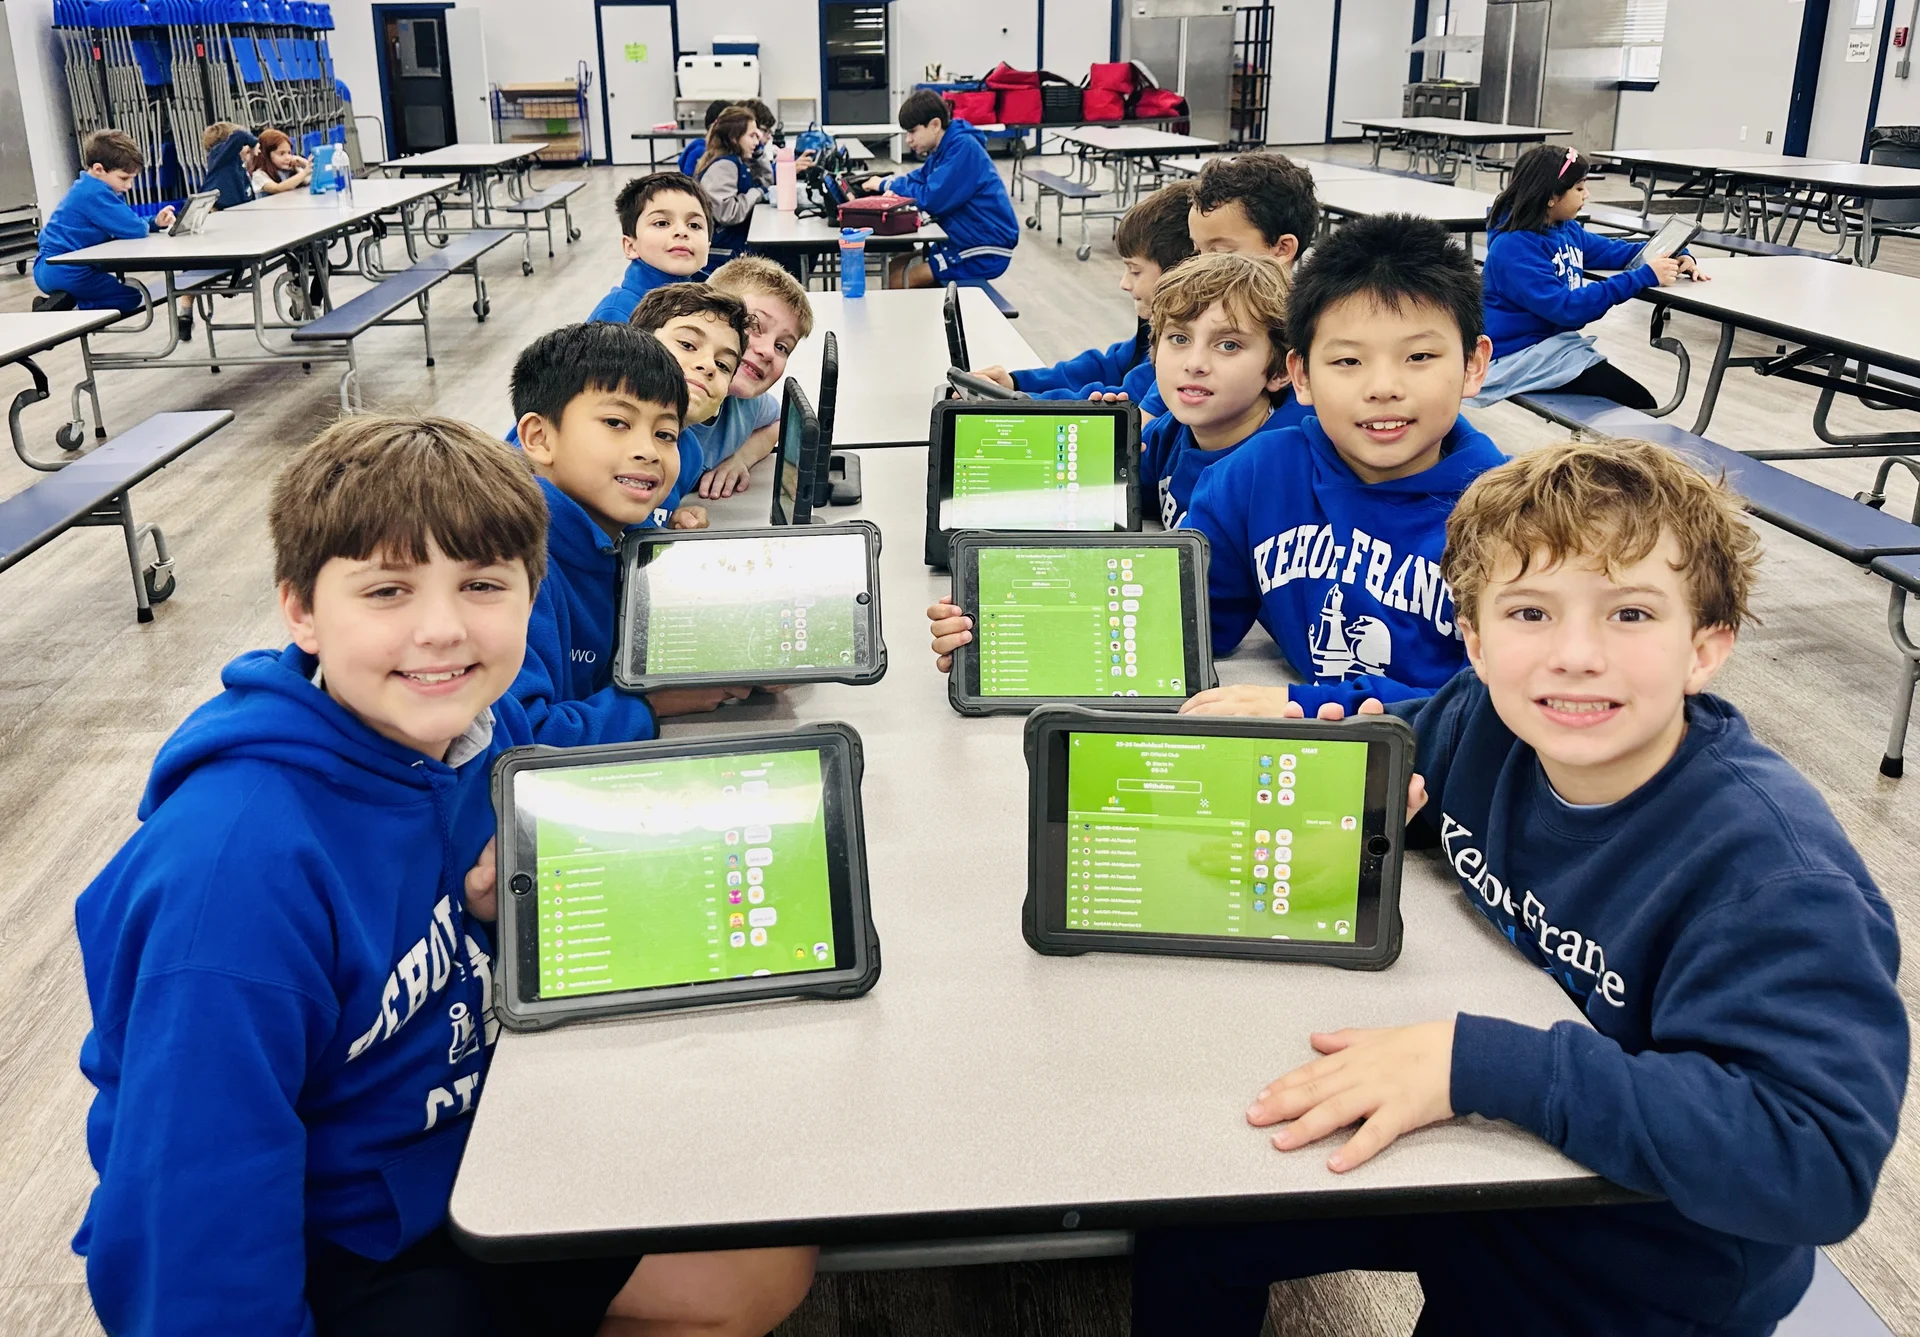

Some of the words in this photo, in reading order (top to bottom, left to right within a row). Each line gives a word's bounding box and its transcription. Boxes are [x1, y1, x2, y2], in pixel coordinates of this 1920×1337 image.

[1253, 523, 1464, 641] KEHO-FRANC
[569, 648, 597, 663] WO
[1143, 782, 1175, 791] Withdraw
[1440, 811, 1627, 1008] Keo-Frane
